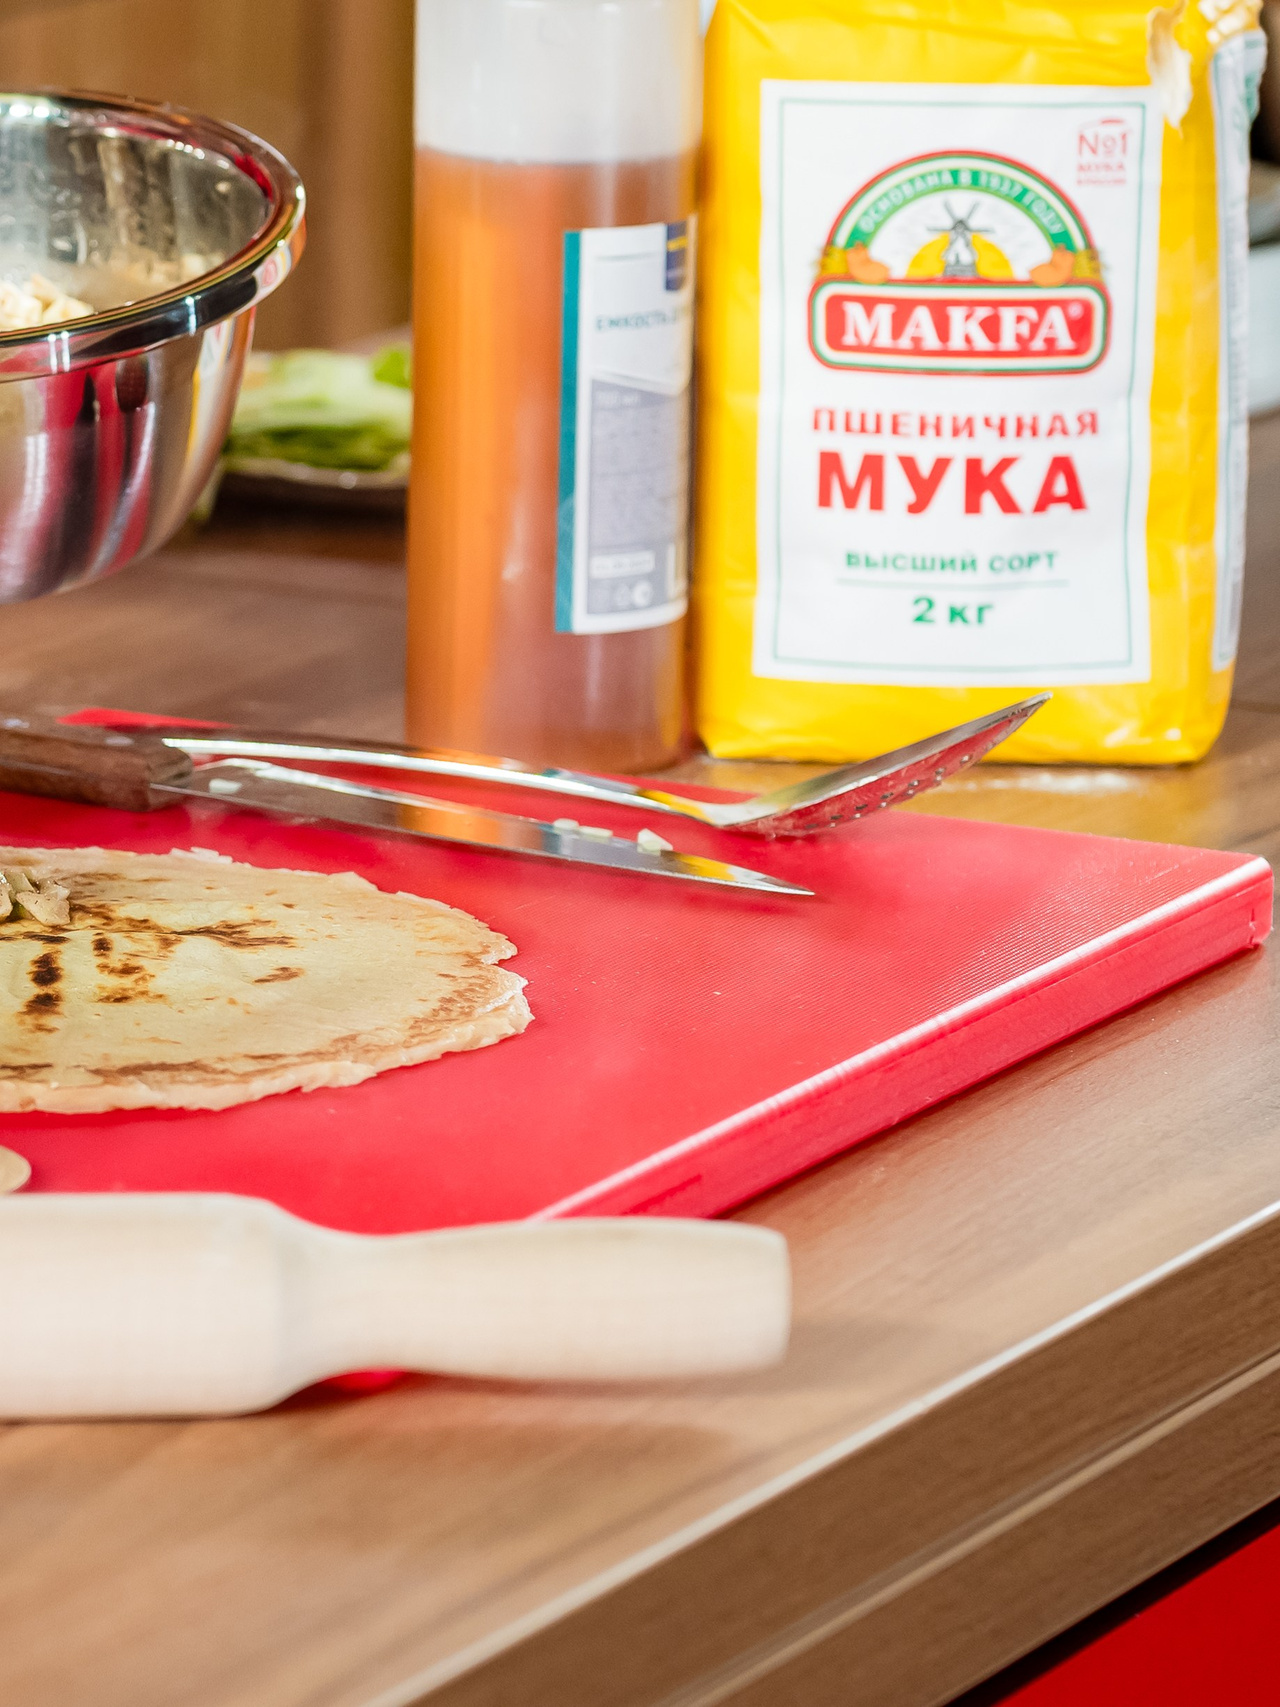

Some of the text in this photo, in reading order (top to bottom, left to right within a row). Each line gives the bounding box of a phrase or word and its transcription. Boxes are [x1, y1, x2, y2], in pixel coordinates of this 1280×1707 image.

[841, 301, 1077, 351] MAKFA
[813, 408, 1099, 438] ПШЕНИЧНАЯ
[818, 451, 1087, 514] МУКА
[845, 552, 1056, 573] ВЫСШИЙ СОРТ
[912, 597, 936, 624] 2
